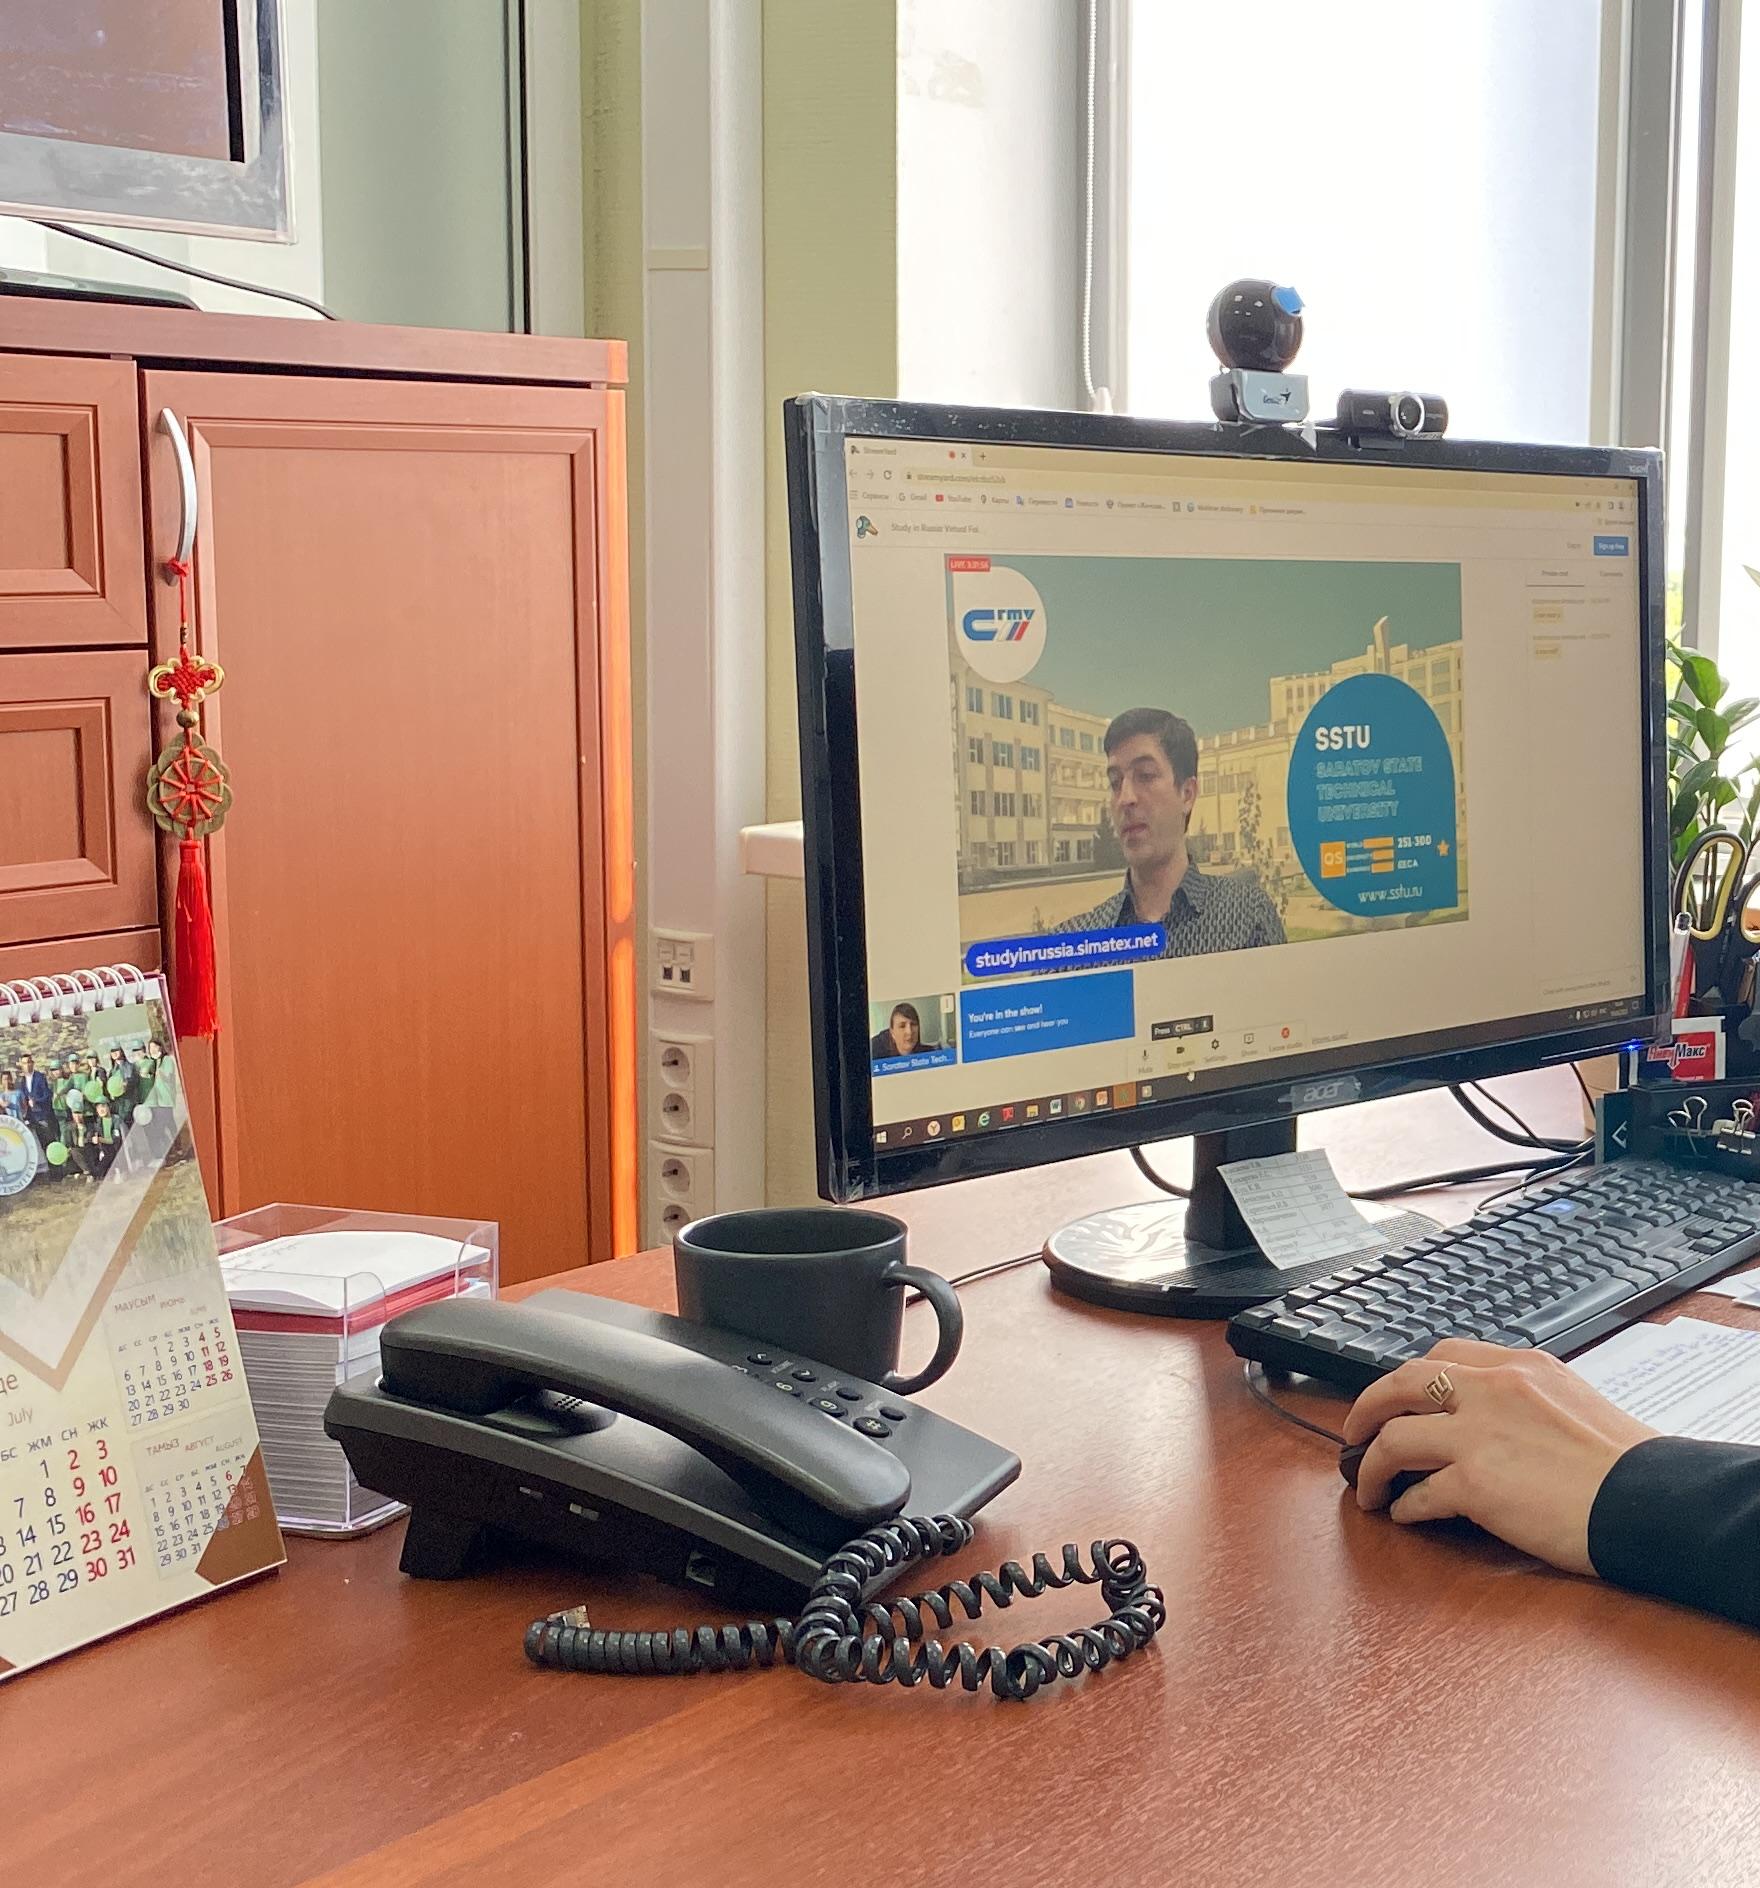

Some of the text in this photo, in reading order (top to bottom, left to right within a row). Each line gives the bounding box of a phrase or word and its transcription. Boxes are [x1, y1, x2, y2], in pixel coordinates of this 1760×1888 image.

[1315, 725, 1371, 751] SSTU
[1316, 756, 1423, 778] SARATOV STATE
[1316, 779, 1395, 801] TECHNICAL
[1317, 801, 1399, 822] UNIVERSITY
[975, 932, 1159, 968] studyinrussia.simatex.net
[968, 1004, 1043, 1024] You're in the show!
[969, 1026, 999, 1040] Everyone
[1303, 1081, 1344, 1102] acer
[154, 1327, 220, 1356] 1 2 3 4 5
[124, 1341, 226, 1381] 6 7 8 9 10 11 12
[126, 1355, 228, 1395] 13 14 15 16 17 18 19
[128, 1369, 233, 1411] 20 21 22 23 24 25 26
[775, 1380, 793, 1391] 6
[7, 1408, 33, 1427] July
[131, 1399, 190, 1426] 27 28 29 30
[820, 1399, 837, 1411] 9
[1, 1417, 109, 1462] БС ЖМ СН ЖК
[40, 1439, 108, 1478] 1 2 3
[14, 1465, 117, 1518] 7 8 9 10
[151, 1465, 246, 1507] 1 2 3 4 5 6 7
[17, 1525, 37, 1547] 14
[47, 1514, 66, 1536] 15
[75, 1502, 95, 1526] 16
[105, 1493, 121, 1514] 17
[153, 1512, 159, 1522] 8
[168, 1506, 174, 1516] 9
[182, 1500, 192, 1511] 10
[198, 1495, 206, 1505] 11
[212, 1490, 222, 1500] 12
[155, 1503, 225, 1537] 15 16 17 18 19
[24, 1552, 42, 1576] 21
[51, 1541, 73, 1565] 22
[81, 1530, 102, 1554] 23
[109, 1519, 131, 1544] 24
[157, 1523, 214, 1552] 22 23 24 25
[160, 1543, 200, 1566] 29 30 31
[0, 1546, 136, 1616] 27 28 29 30 31
